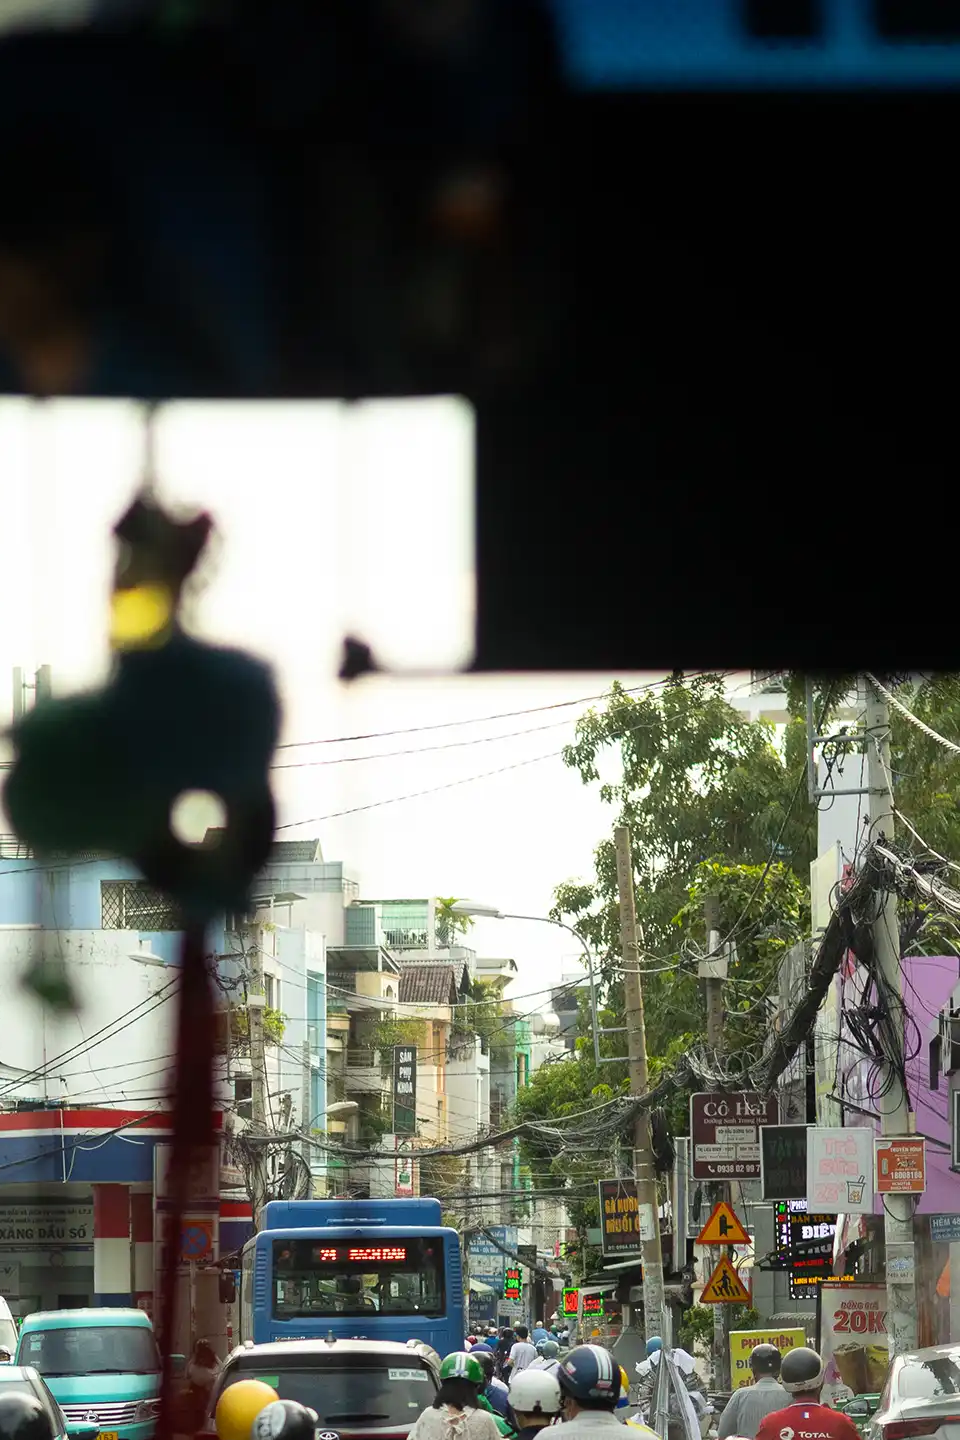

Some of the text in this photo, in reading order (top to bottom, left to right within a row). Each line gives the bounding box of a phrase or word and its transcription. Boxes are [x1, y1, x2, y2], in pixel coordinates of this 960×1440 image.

[704, 1100, 729, 1117] Cô
[69, 1223, 87, 1239] SỐ
[832, 1309, 888, 1334] 20K
